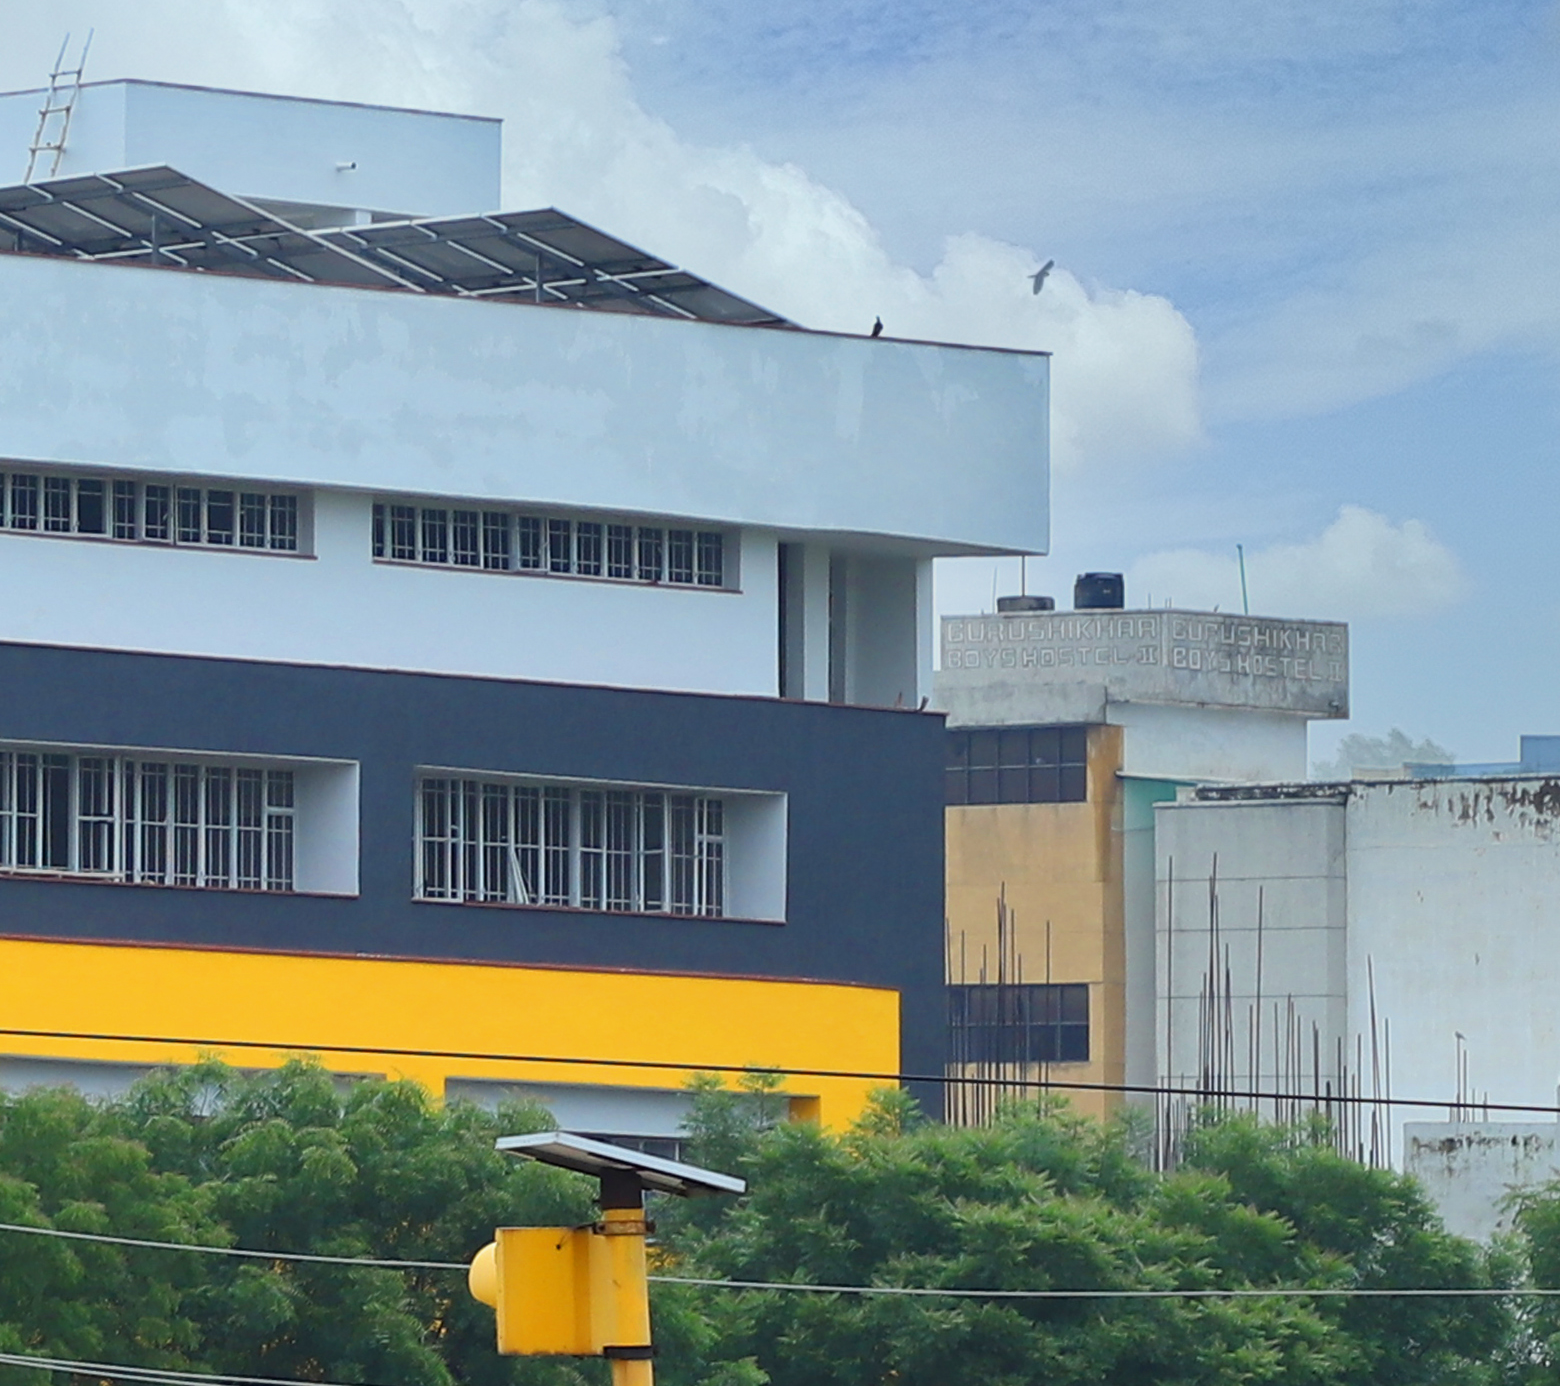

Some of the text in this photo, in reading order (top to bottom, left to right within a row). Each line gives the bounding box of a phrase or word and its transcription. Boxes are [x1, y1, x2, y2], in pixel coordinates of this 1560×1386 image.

[947, 646, 1014, 669] BOYS
[1022, 646, 1127, 669] HOSTEL
[1173, 646, 1231, 674] BOYS
[1237, 653, 1322, 681] HOSTEL
